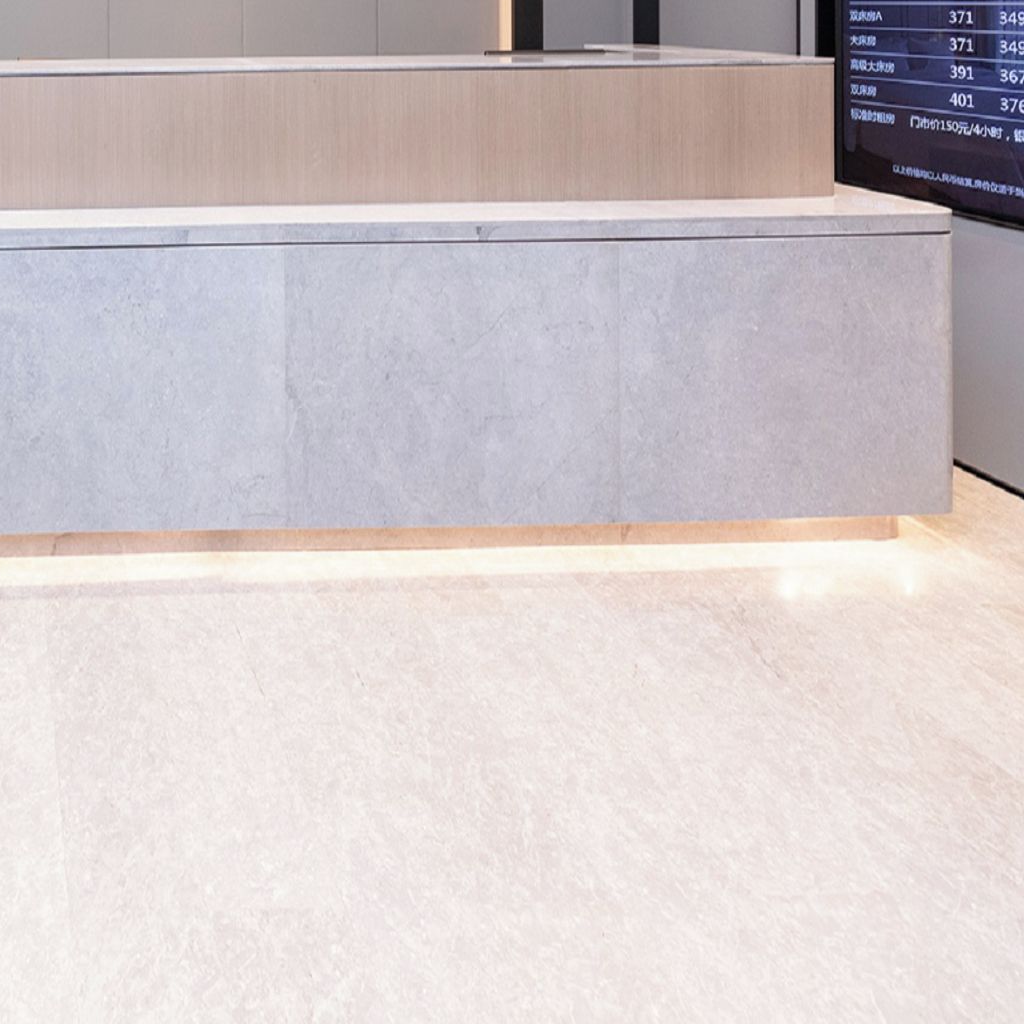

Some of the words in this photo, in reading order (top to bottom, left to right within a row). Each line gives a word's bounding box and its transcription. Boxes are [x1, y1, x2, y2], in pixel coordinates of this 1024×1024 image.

[948, 10, 974, 25] 371
[999, 11, 1024, 26] 349
[849, 34, 877, 47] 大床房
[949, 37, 974, 53] 371
[999, 40, 1024, 56] 349
[849, 59, 895, 74] 高级大床房
[949, 65, 975, 81] 391
[999, 68, 1024, 85] 367
[849, 84, 877, 97] 双床房
[949, 92, 975, 108] 401
[1000, 97, 1024, 114] 376
